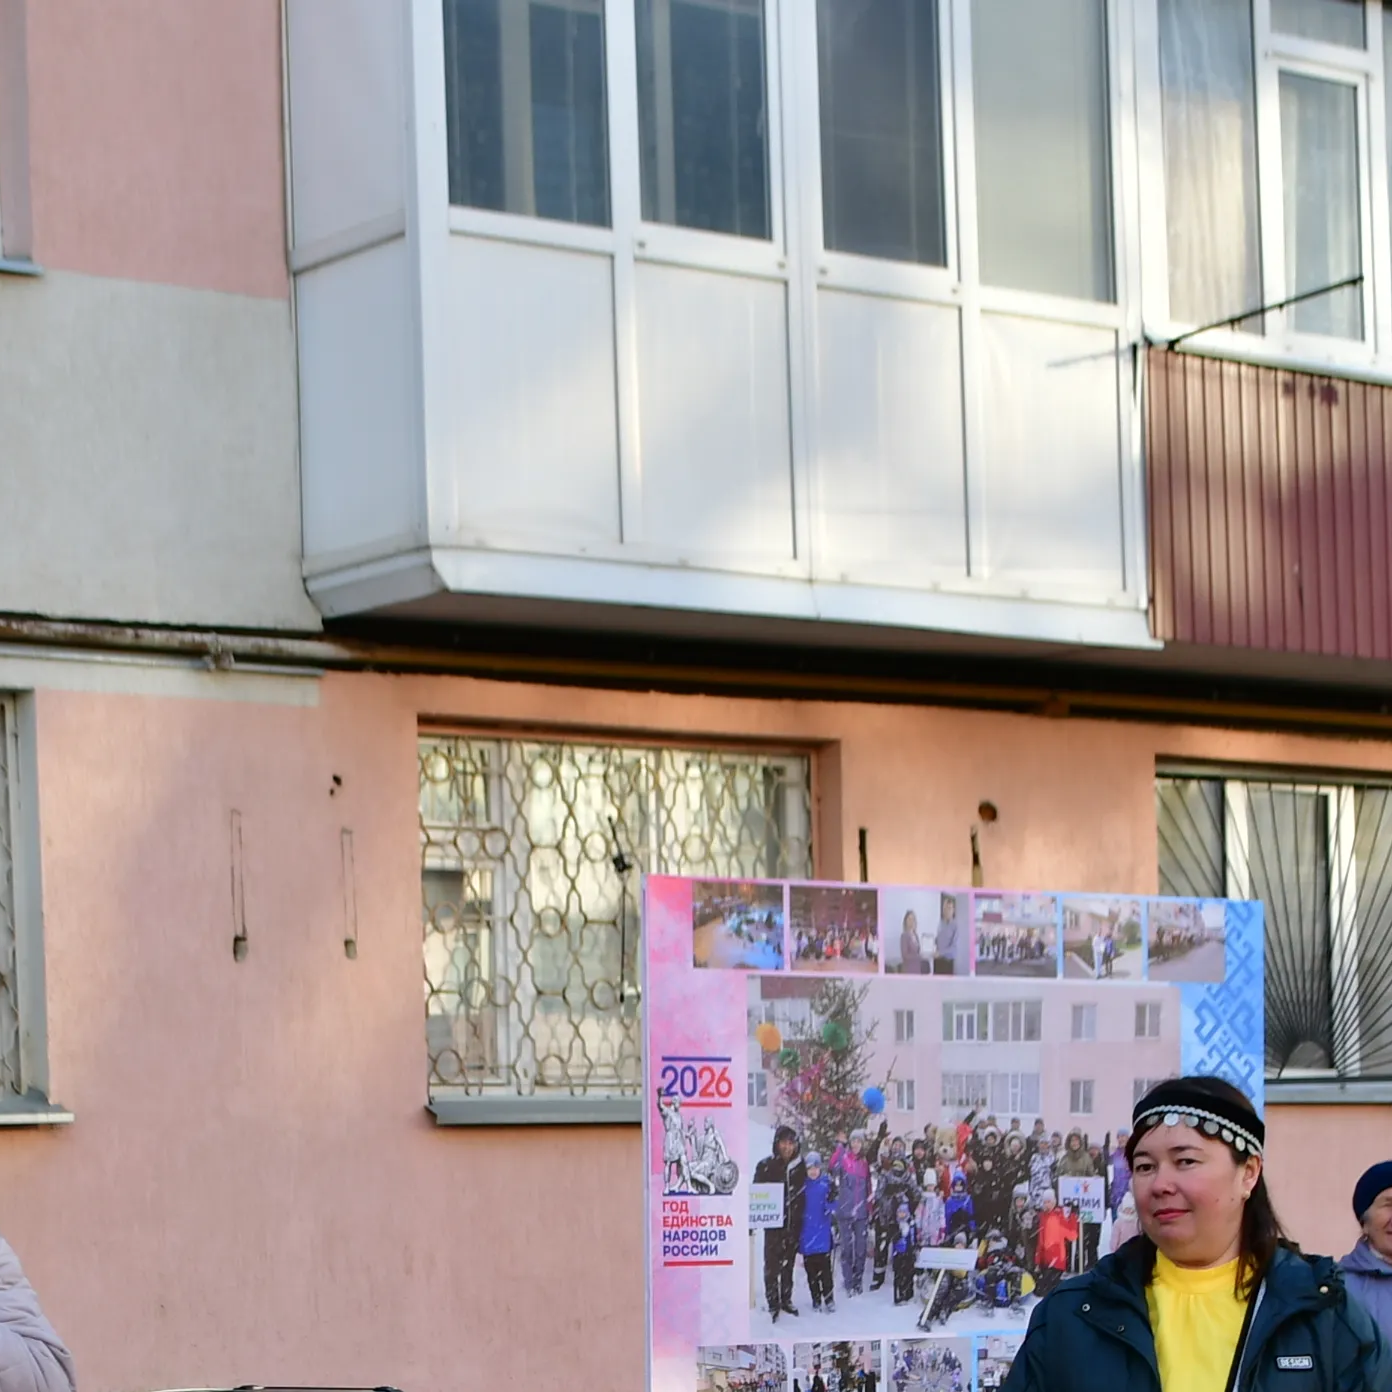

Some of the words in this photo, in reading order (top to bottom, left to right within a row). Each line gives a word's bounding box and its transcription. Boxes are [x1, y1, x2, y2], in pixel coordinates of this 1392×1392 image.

[661, 1065, 733, 1098] 2026
[662, 1201, 689, 1213] ГОД
[663, 1215, 733, 1228] ЕДИНСТВА
[663, 1229, 727, 1242] НАРОДОВ
[663, 1244, 719, 1256] РОССИИ
